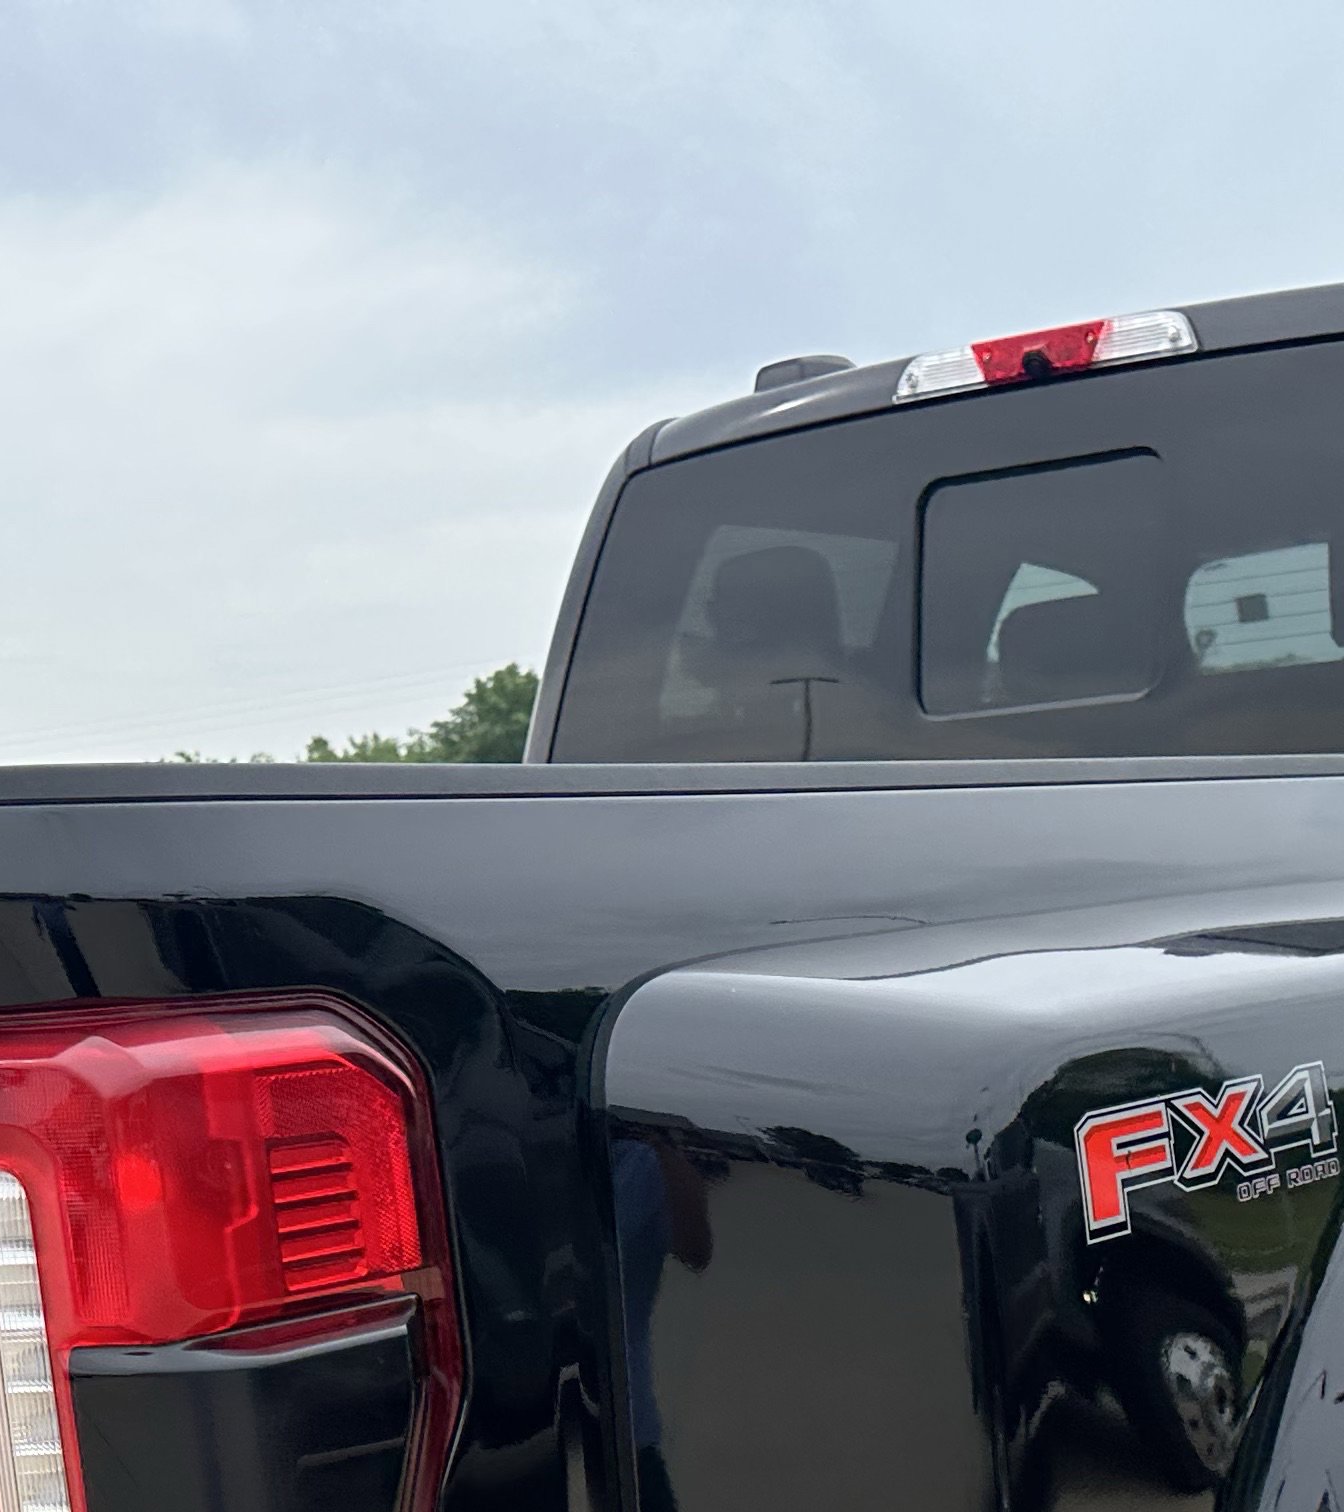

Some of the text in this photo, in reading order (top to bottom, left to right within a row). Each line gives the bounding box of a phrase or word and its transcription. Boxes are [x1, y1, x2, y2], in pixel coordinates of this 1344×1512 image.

[1073, 1060, 1339, 1245] FX4
[1235, 1156, 1341, 1202] OFF ROAD
